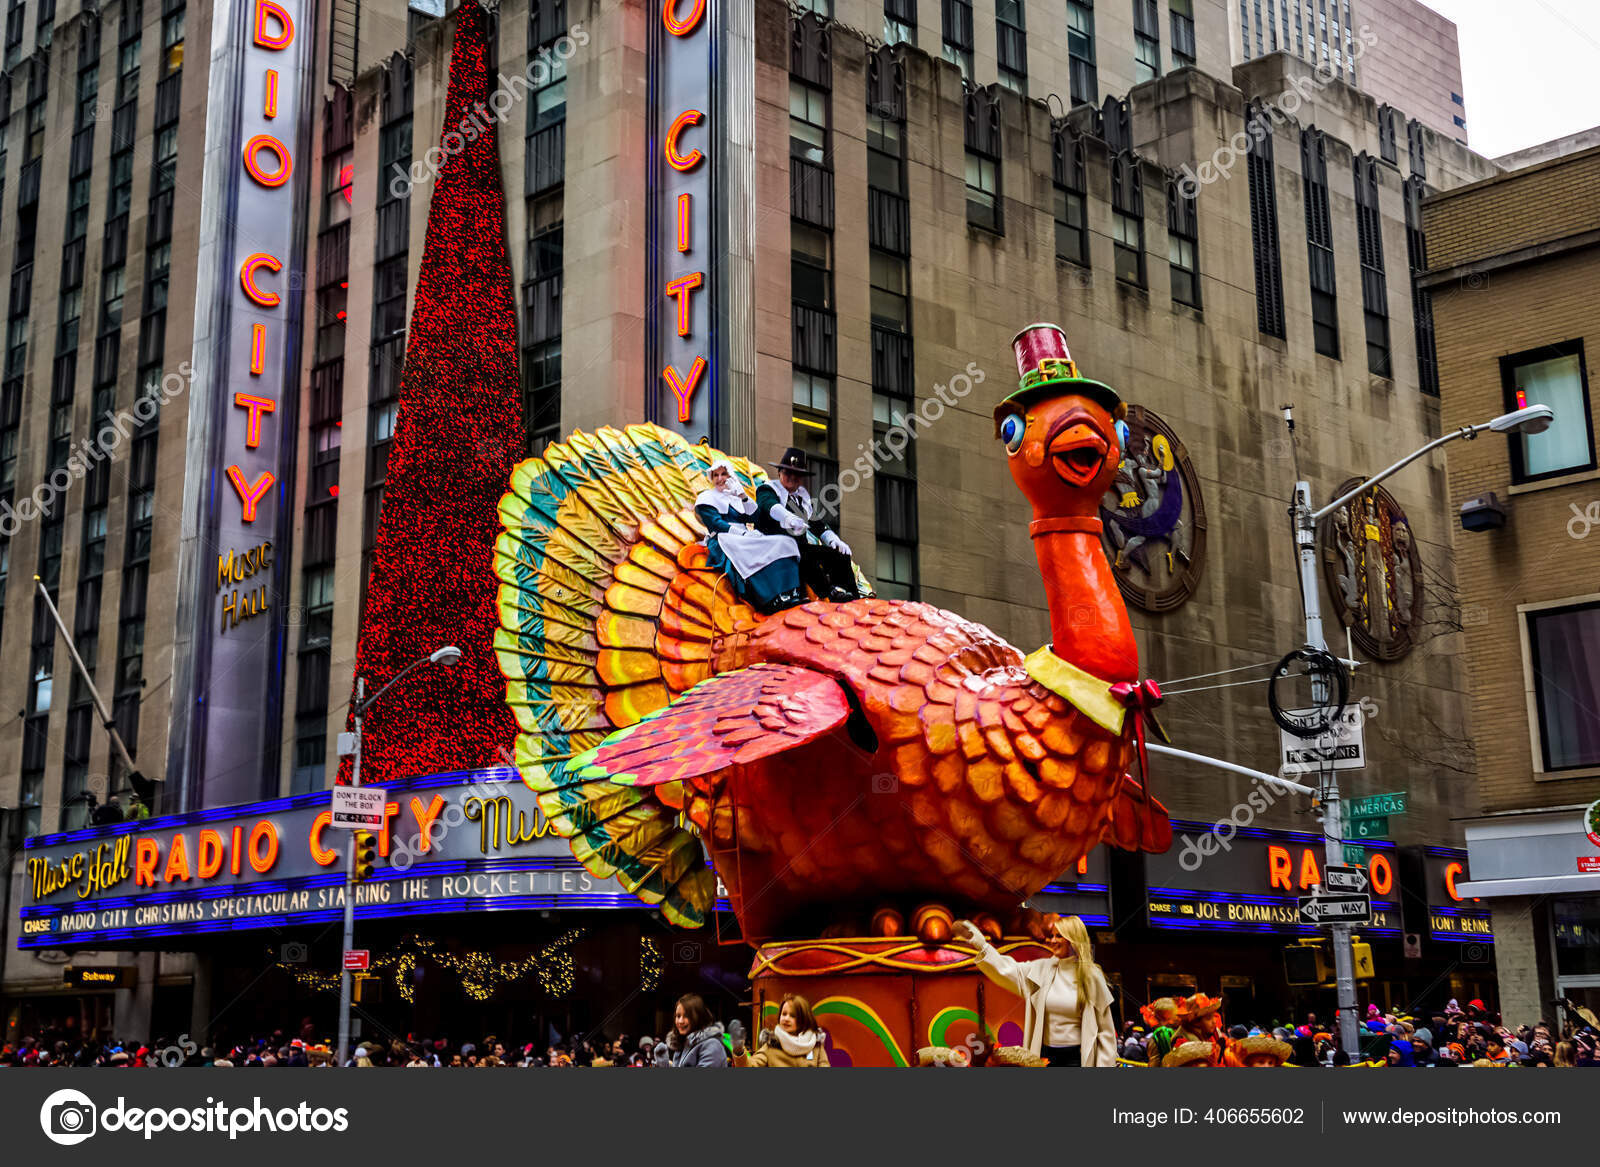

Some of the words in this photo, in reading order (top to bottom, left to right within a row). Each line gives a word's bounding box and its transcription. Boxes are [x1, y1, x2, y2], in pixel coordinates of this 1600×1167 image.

[663, 110, 707, 423] CITY
[226, 253, 282, 522] CITY
[217, 542, 272, 592] MUSIC
[221, 585, 269, 633] HALL
[359, 793, 382, 801] BLOCK
[1353, 800, 1405, 816] AMERICAS
[1359, 821, 1368, 836] 6
[27, 853, 83, 900] Music
[77, 834, 131, 899] Hall
[135, 820, 279, 887] RADIO
[308, 793, 445, 867] CTY
[1268, 845, 1393, 896] RAO
[1329, 873, 1344, 884] ONE
[1350, 875, 1364, 886] WAY
[24, 919, 52, 933] CHASE
[61, 912, 96, 932] RADIO
[101, 909, 128, 928] CITY
[135, 901, 204, 925] CHRISTMAS
[211, 890, 310, 918] SPECTACULAR
[317, 883, 391, 908] STARING
[402, 878, 430, 900] THE
[442, 871, 593, 898] ROCKETTES
[1149, 902, 1172, 913] CHASE
[1195, 902, 1221, 919] JOE
[1228, 904, 1300, 923] BONAMASSA
[1306, 904, 1329, 915] ONE
[1340, 903, 1364, 915] WAY
[1431, 916, 1455, 931] TONY
[82, 971, 116, 982] Subway
